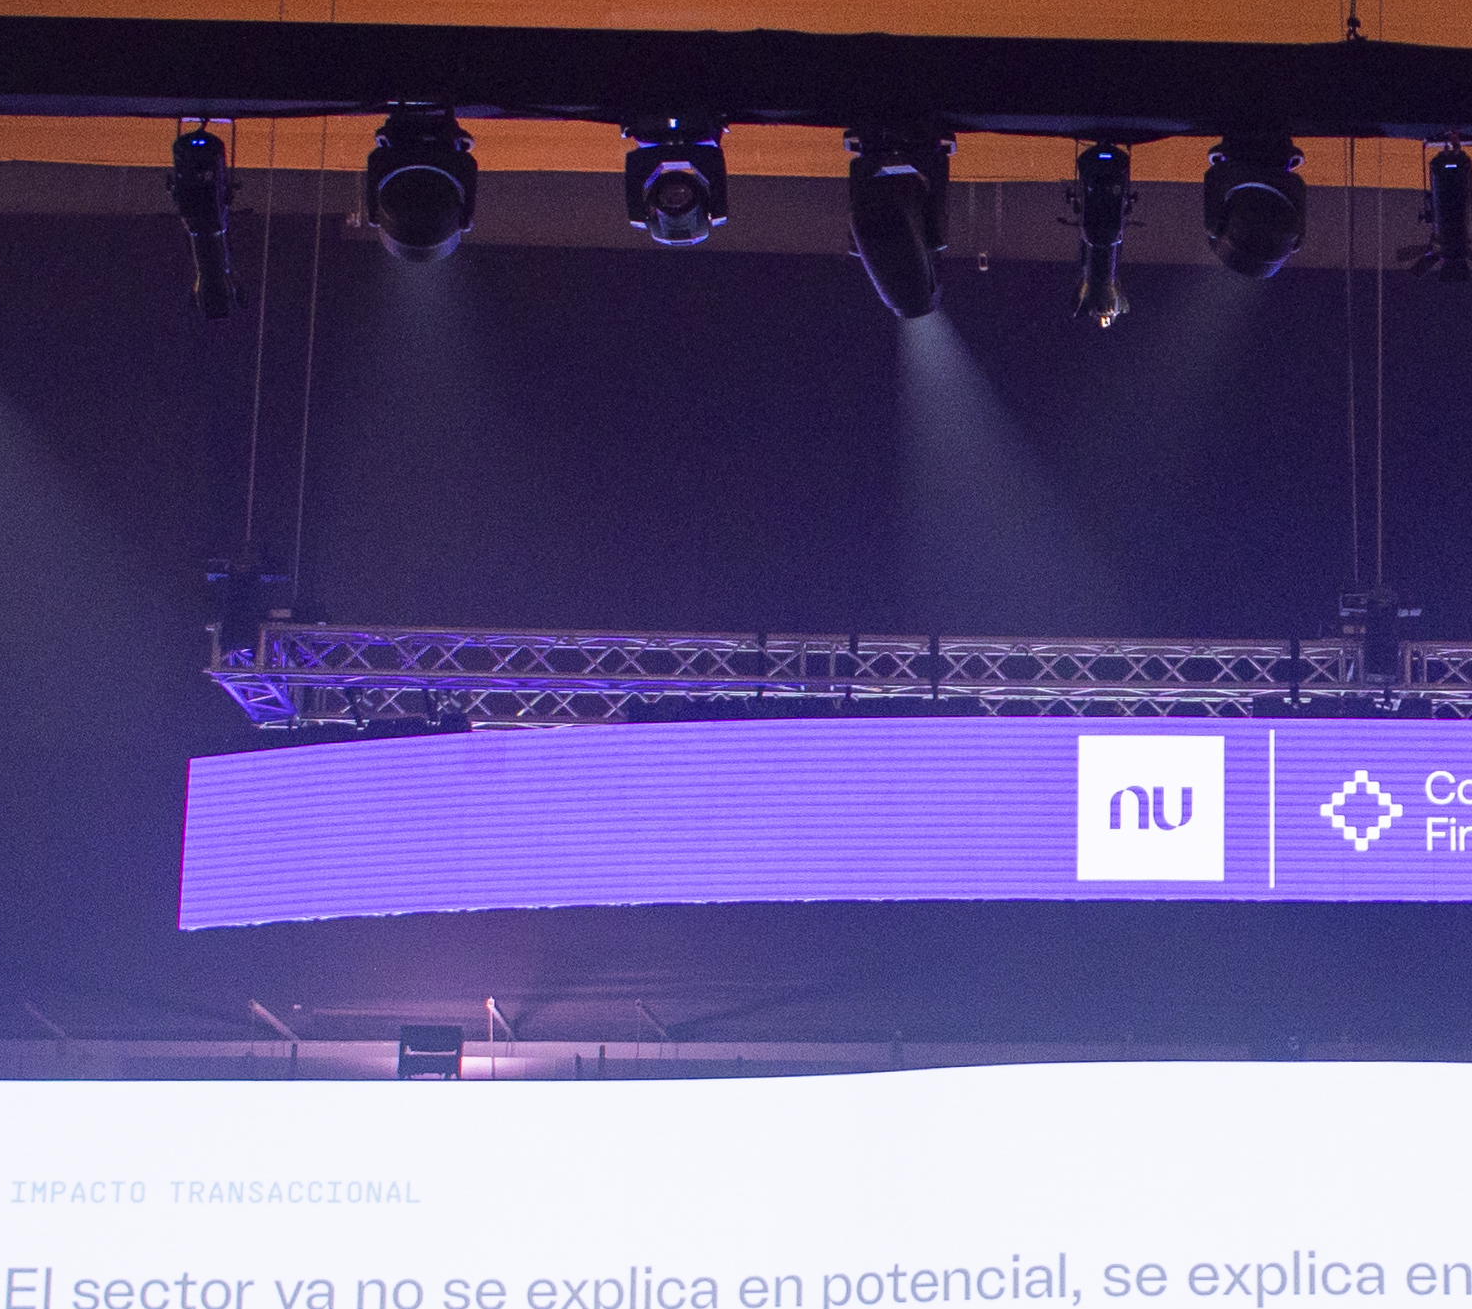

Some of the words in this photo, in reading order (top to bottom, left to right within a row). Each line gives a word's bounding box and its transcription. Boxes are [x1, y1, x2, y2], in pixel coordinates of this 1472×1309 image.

[11, 1181, 145, 1203] IMPACTO
[170, 1181, 421, 1203] TRANSACCIONAL
[739, 1275, 802, 1309] en
[1103, 1263, 1167, 1297] se
[1188, 1250, 1385, 1308] explica
[1406, 1262, 1472, 1296] en
